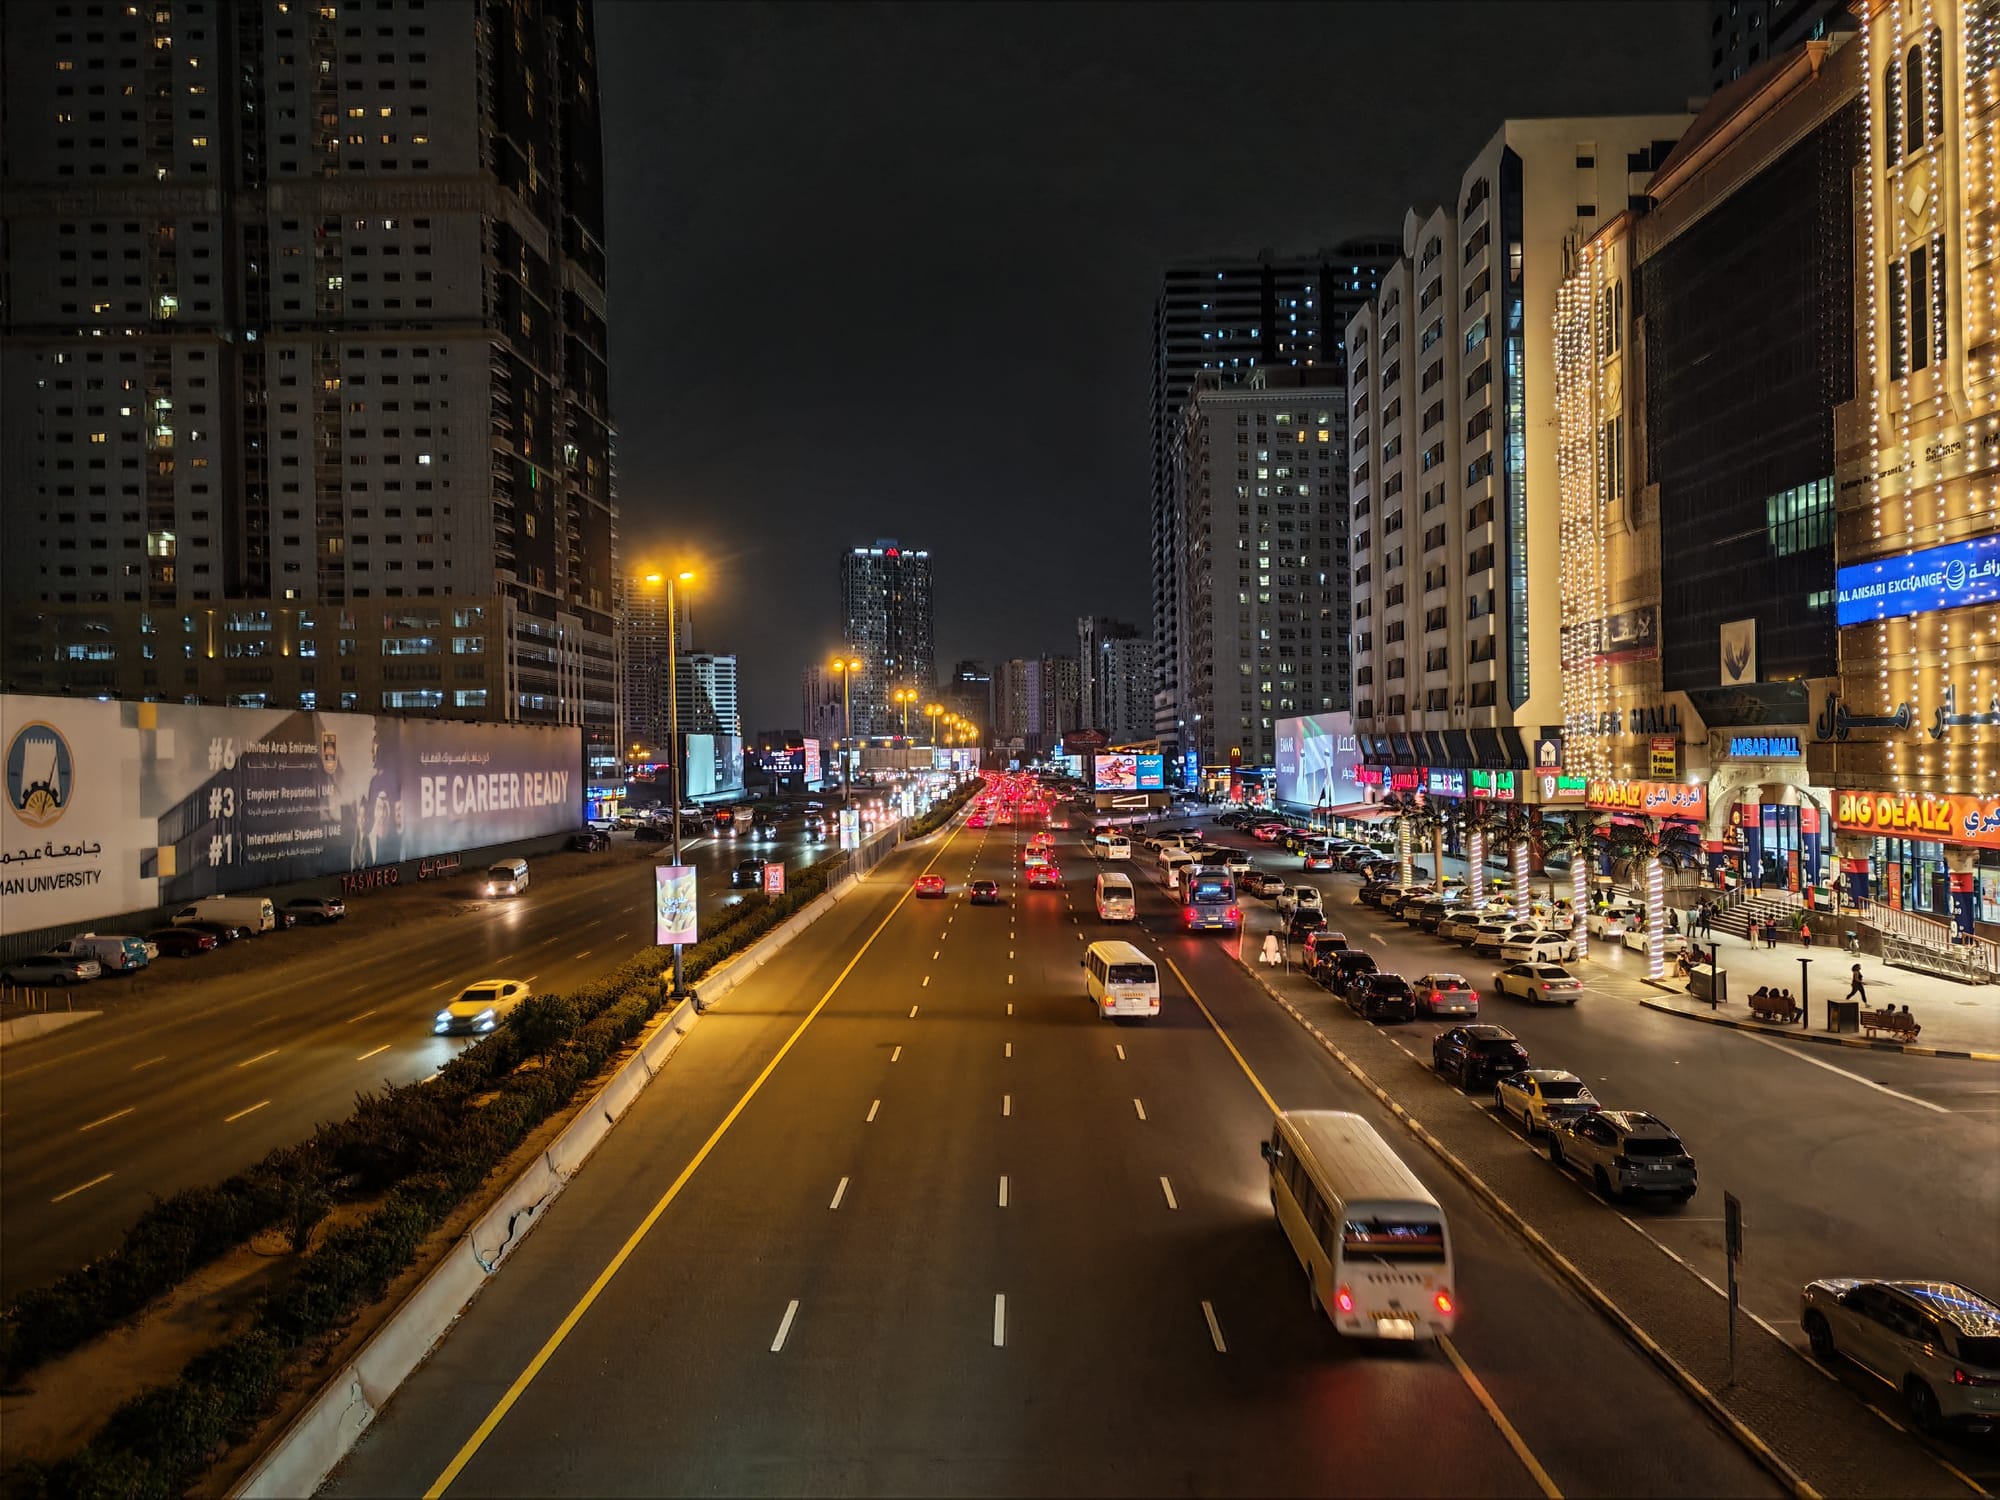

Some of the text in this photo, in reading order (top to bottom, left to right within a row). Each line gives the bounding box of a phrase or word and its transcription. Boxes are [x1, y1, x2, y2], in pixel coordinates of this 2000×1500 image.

[1838, 572, 1943, 603] AL ANSARI EXCHANGE
[1629, 704, 1681, 735] MALL
[208, 737, 318, 771] #6 United Arab Emirates
[1730, 737, 1800, 757] ANSAR MALL
[209, 787, 235, 819] #3
[247, 788, 280, 802] Employer
[281, 785, 316, 800] Reputation
[420, 770, 569, 818] BE CAREER READY
[1588, 783, 1641, 806] BIG DEALZ
[1839, 794, 1951, 831] BIG DEALZ
[44, 840, 101, 858] جامعة
[208, 834, 233, 866] #1
[247, 829, 293, 846] International
[294, 826, 323, 840] Students
[28, 869, 101, 893] UNIVERSITY
